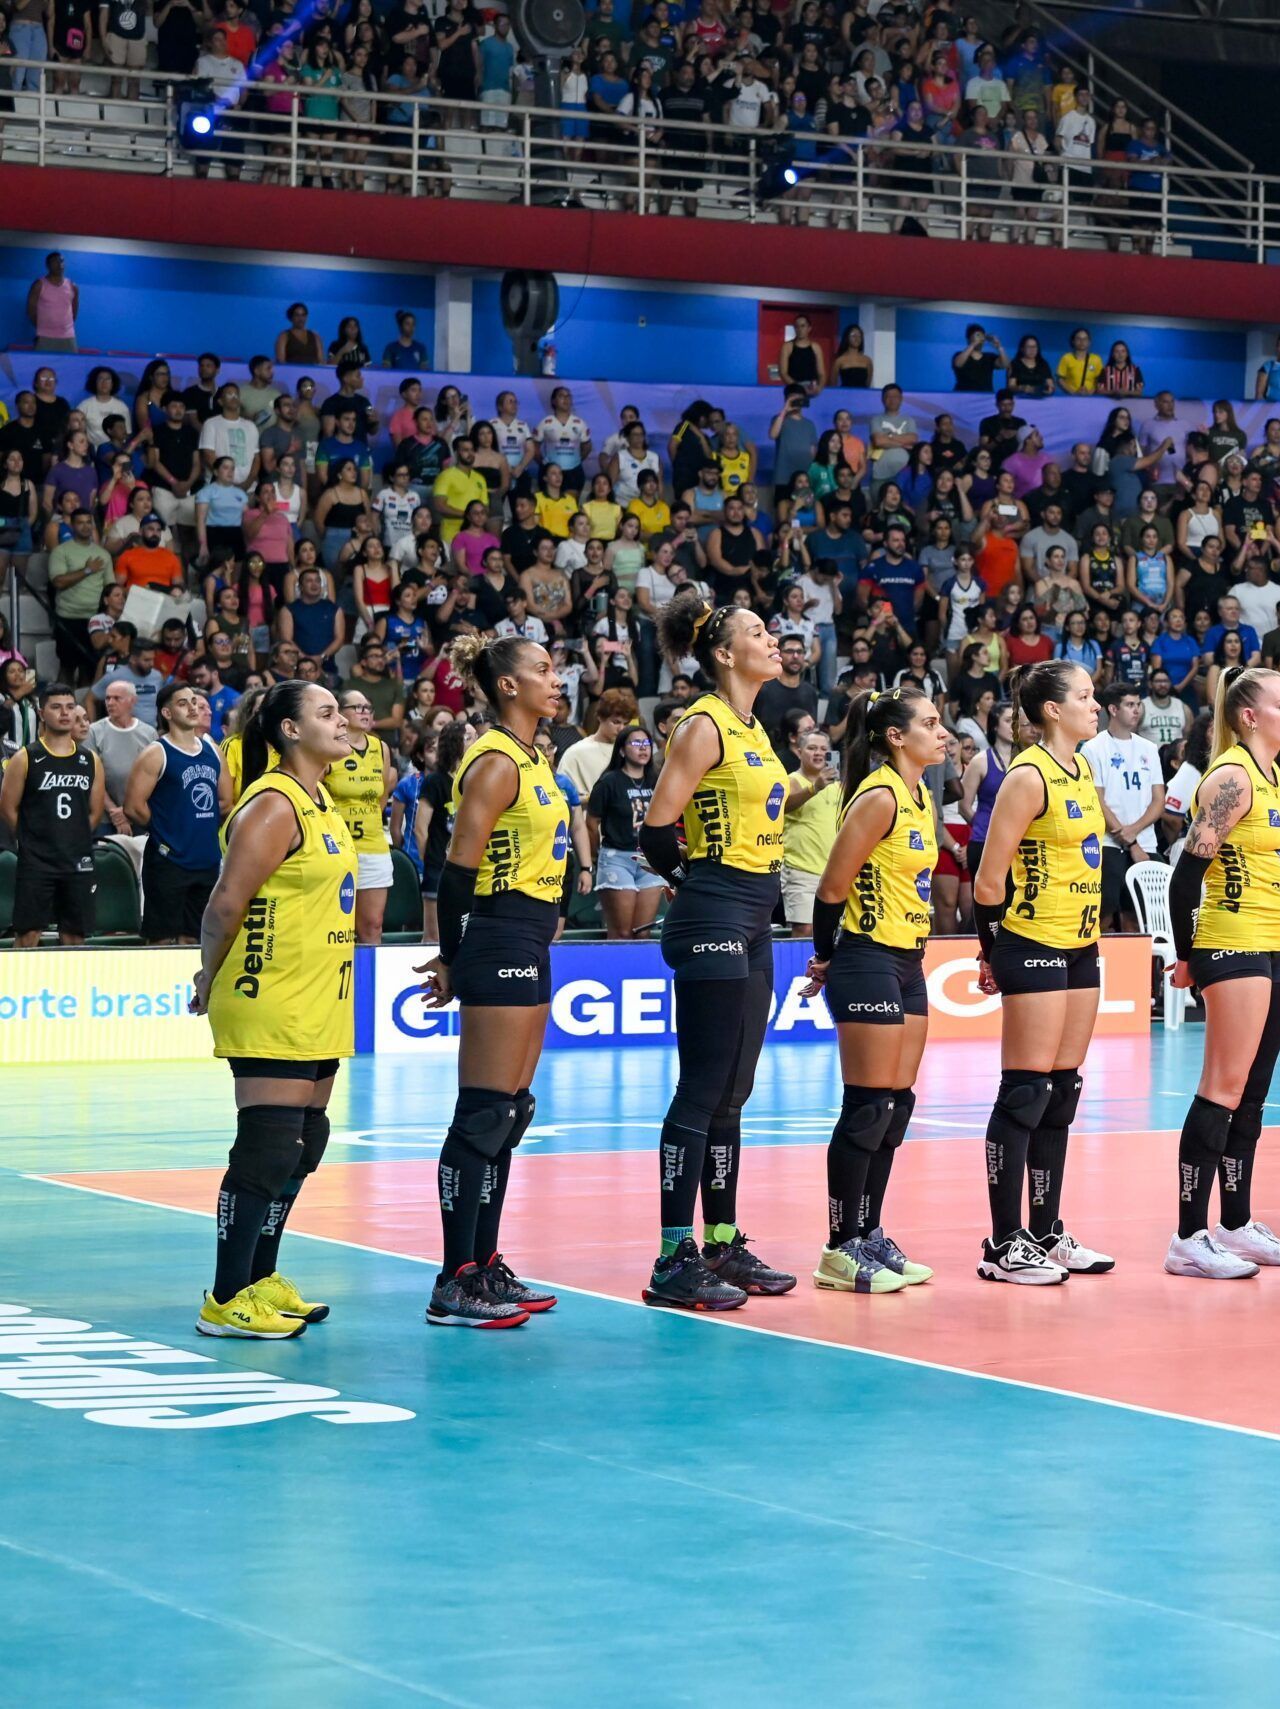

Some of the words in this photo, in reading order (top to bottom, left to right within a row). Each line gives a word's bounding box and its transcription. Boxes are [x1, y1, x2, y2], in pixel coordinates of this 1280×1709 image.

[1160, 729, 1172, 742] 11
[38, 771, 91, 790] LAKERS
[1122, 771, 1142, 790] 14
[56, 793, 72, 819] 6
[721, 788, 729, 819] sorriu.
[767, 796, 782, 806] NIVEA
[723, 822, 732, 848] Usou,
[1084, 846, 1101, 855] NIVEA
[341, 888, 354, 898] NIVEA
[268, 897, 278, 931] sorriu.
[1077, 905, 1098, 938] 15
[234, 897, 268, 999] Dentil
[265, 932, 275, 961] Usou,
[338, 961, 352, 1000] 17
[662, 1143, 678, 1191] Dentil
[711, 1145, 727, 1190] Dentil
[986, 1140, 998, 1185] Dentil
[1225, 1157, 1237, 1192] Dentil
[441, 1163, 453, 1212] Dentil
[1033, 1169, 1045, 1206] Dentil
[1182, 1163, 1193, 1202] Dentil
[218, 1190, 230, 1241] Dentil
[829, 1196, 841, 1233] Dentil
